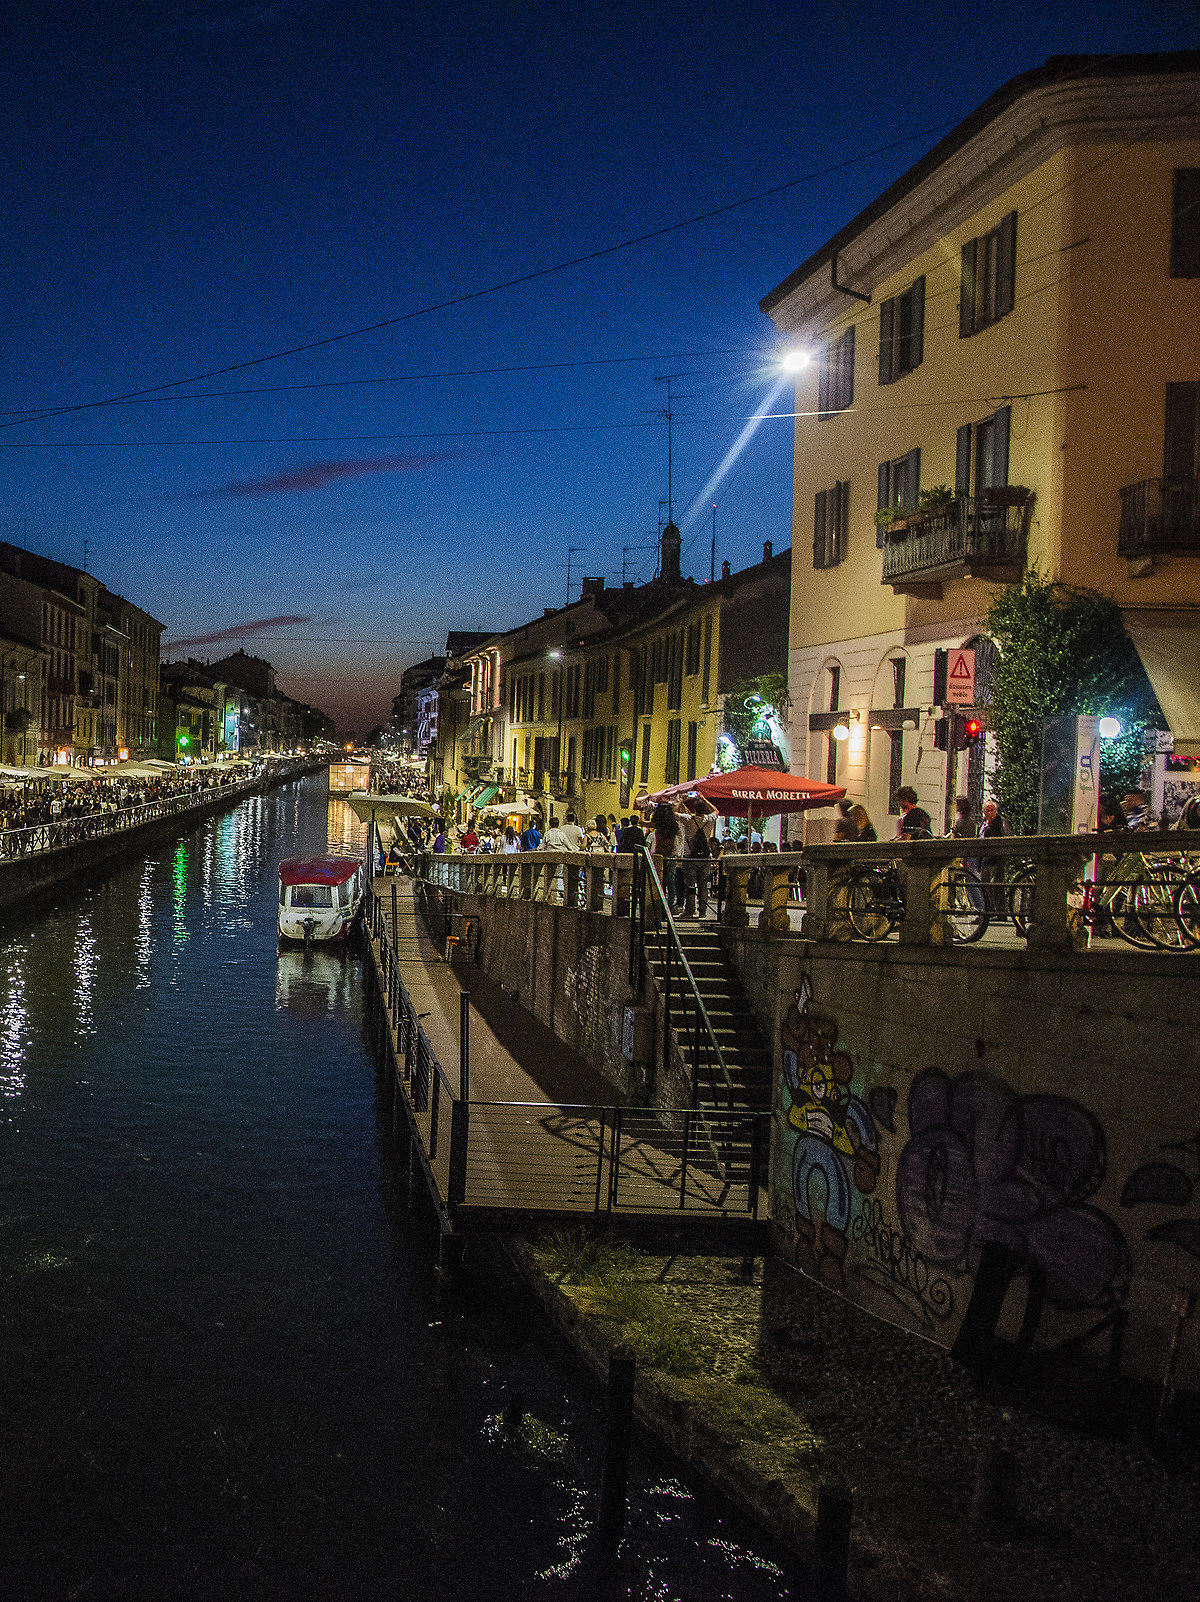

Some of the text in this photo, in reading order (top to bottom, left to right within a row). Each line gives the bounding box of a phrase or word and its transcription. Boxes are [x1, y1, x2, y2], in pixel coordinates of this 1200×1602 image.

[744, 750, 781, 765] PIZZERIA
[731, 789, 810, 800] BIRRA MORETTI
